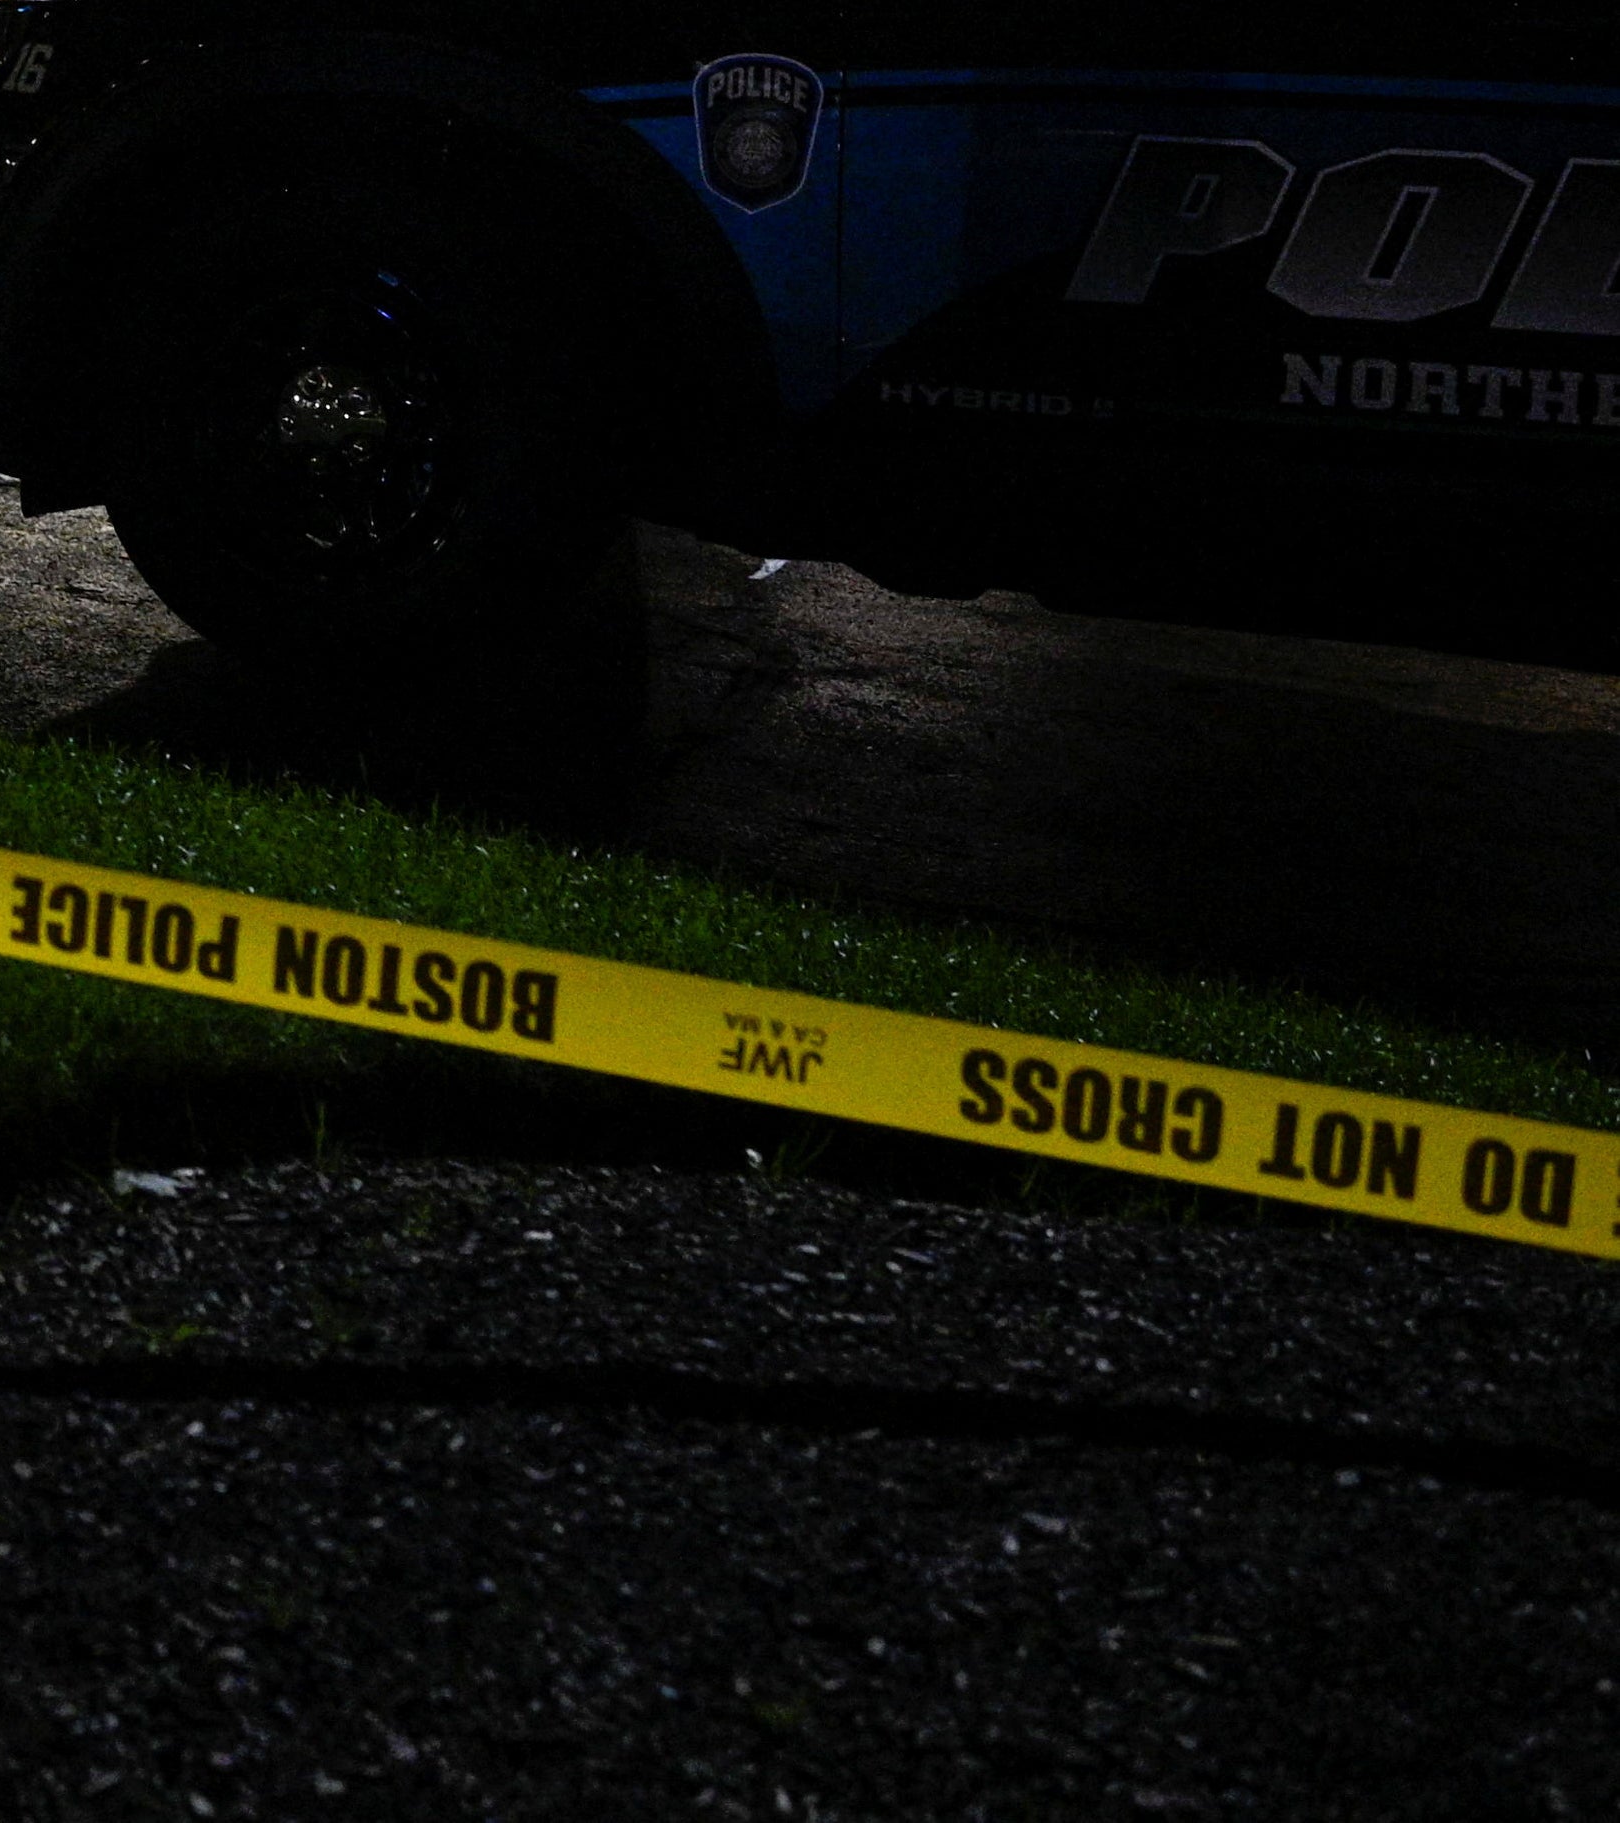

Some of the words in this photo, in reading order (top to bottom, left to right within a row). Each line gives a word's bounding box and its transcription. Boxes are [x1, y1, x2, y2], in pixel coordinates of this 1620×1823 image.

[1, 42, 54, 94] 16
[706, 65, 811, 114] POLICE
[879, 382, 1074, 417] HYBRID
[10, 875, 241, 984] POLICE
[272, 923, 559, 1044] BOSTON
[718, 1036, 824, 1086] JWF
[959, 1046, 1224, 1165] CROSS
[1258, 1103, 1422, 1202] NOT
[1460, 1137, 1578, 1229] DO
